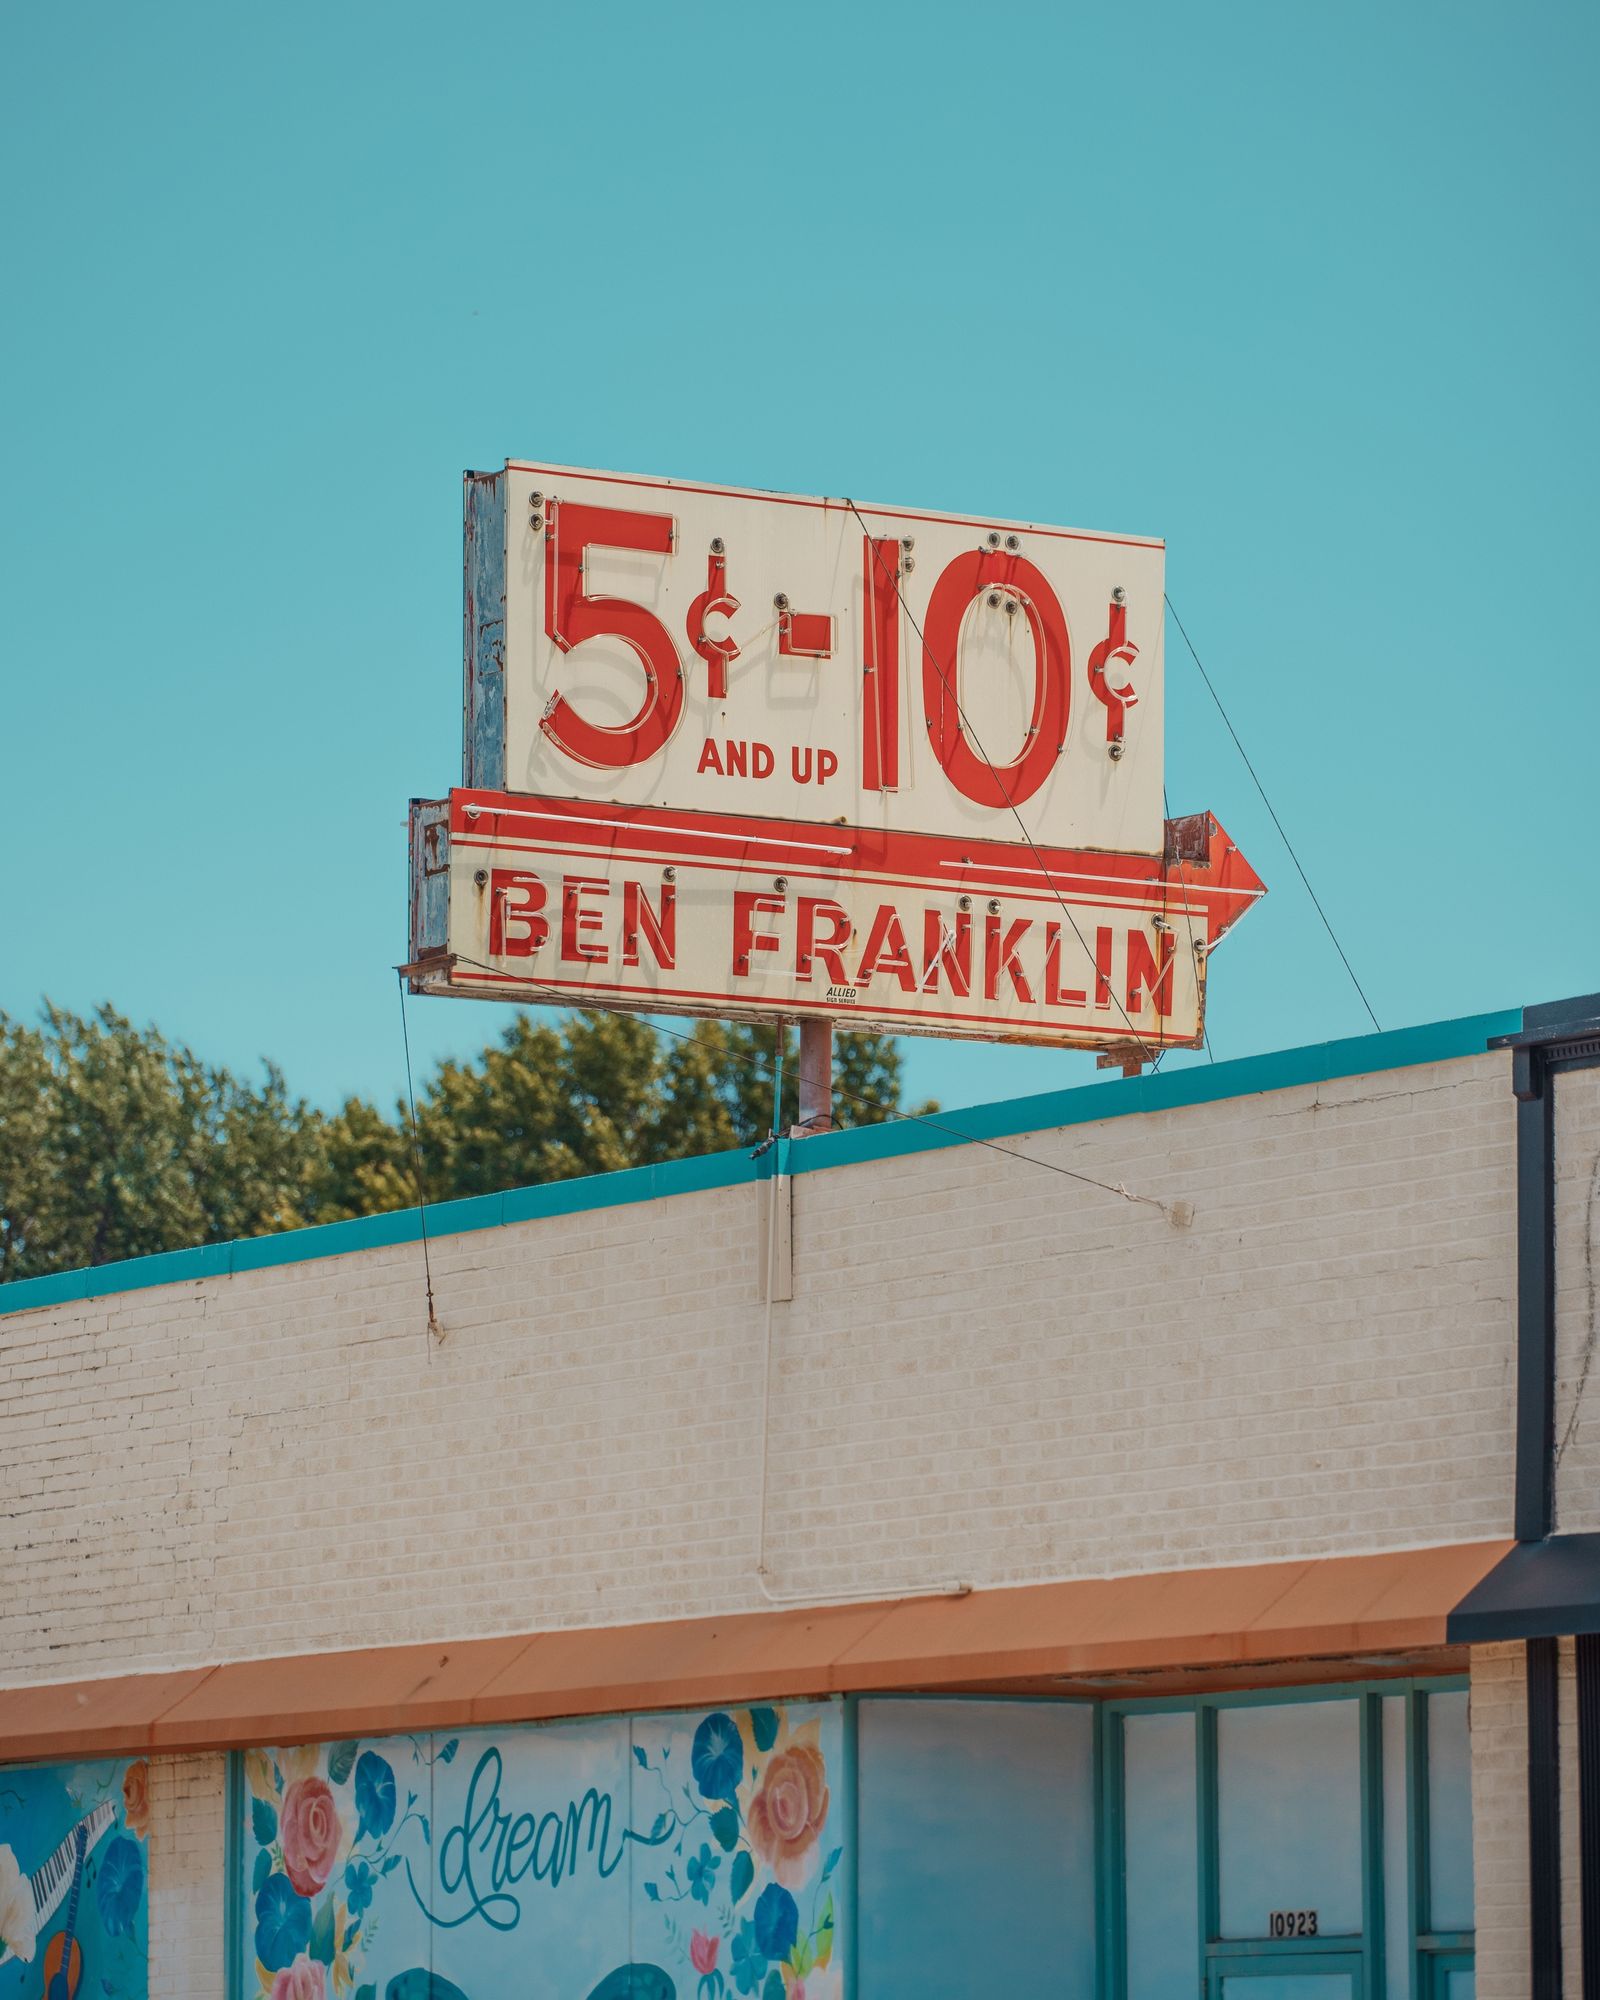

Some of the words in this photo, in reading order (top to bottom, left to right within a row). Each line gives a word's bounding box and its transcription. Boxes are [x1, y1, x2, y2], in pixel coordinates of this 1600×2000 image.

[697, 738, 775, 778] AND
[791, 746, 838, 785] UP
[489, 868, 677, 970] BEN
[733, 890, 1176, 1017] FRANKLIN
[826, 987, 857, 998] ALLIED
[405, 1746, 675, 1931] dream
[1269, 1911, 1318, 1936] 10923
